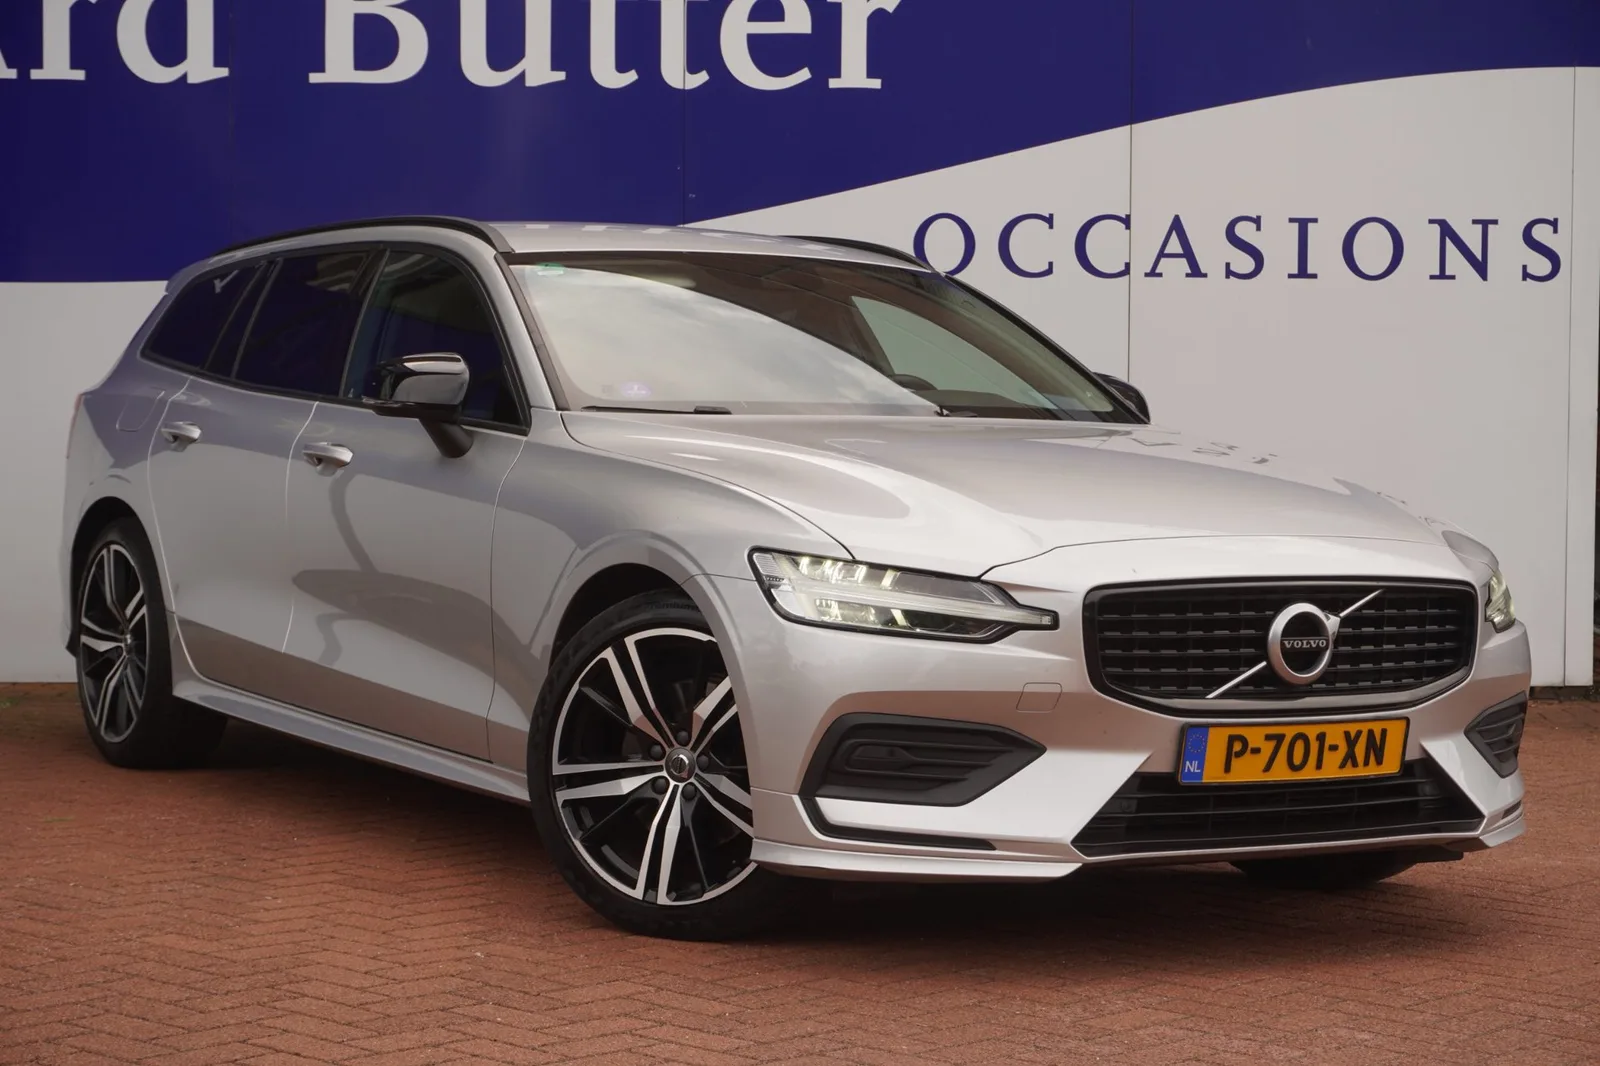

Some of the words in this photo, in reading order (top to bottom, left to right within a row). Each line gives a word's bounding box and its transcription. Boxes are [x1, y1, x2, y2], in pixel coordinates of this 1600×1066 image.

[0, 0, 229, 84] rd
[308, 0, 899, 90] Butter
[912, 212, 1562, 283] OCCASIONS
[1283, 640, 1327, 649] VOLVO
[1185, 760, 1201, 773] NL
[1224, 728, 1388, 774] P-701-XN
